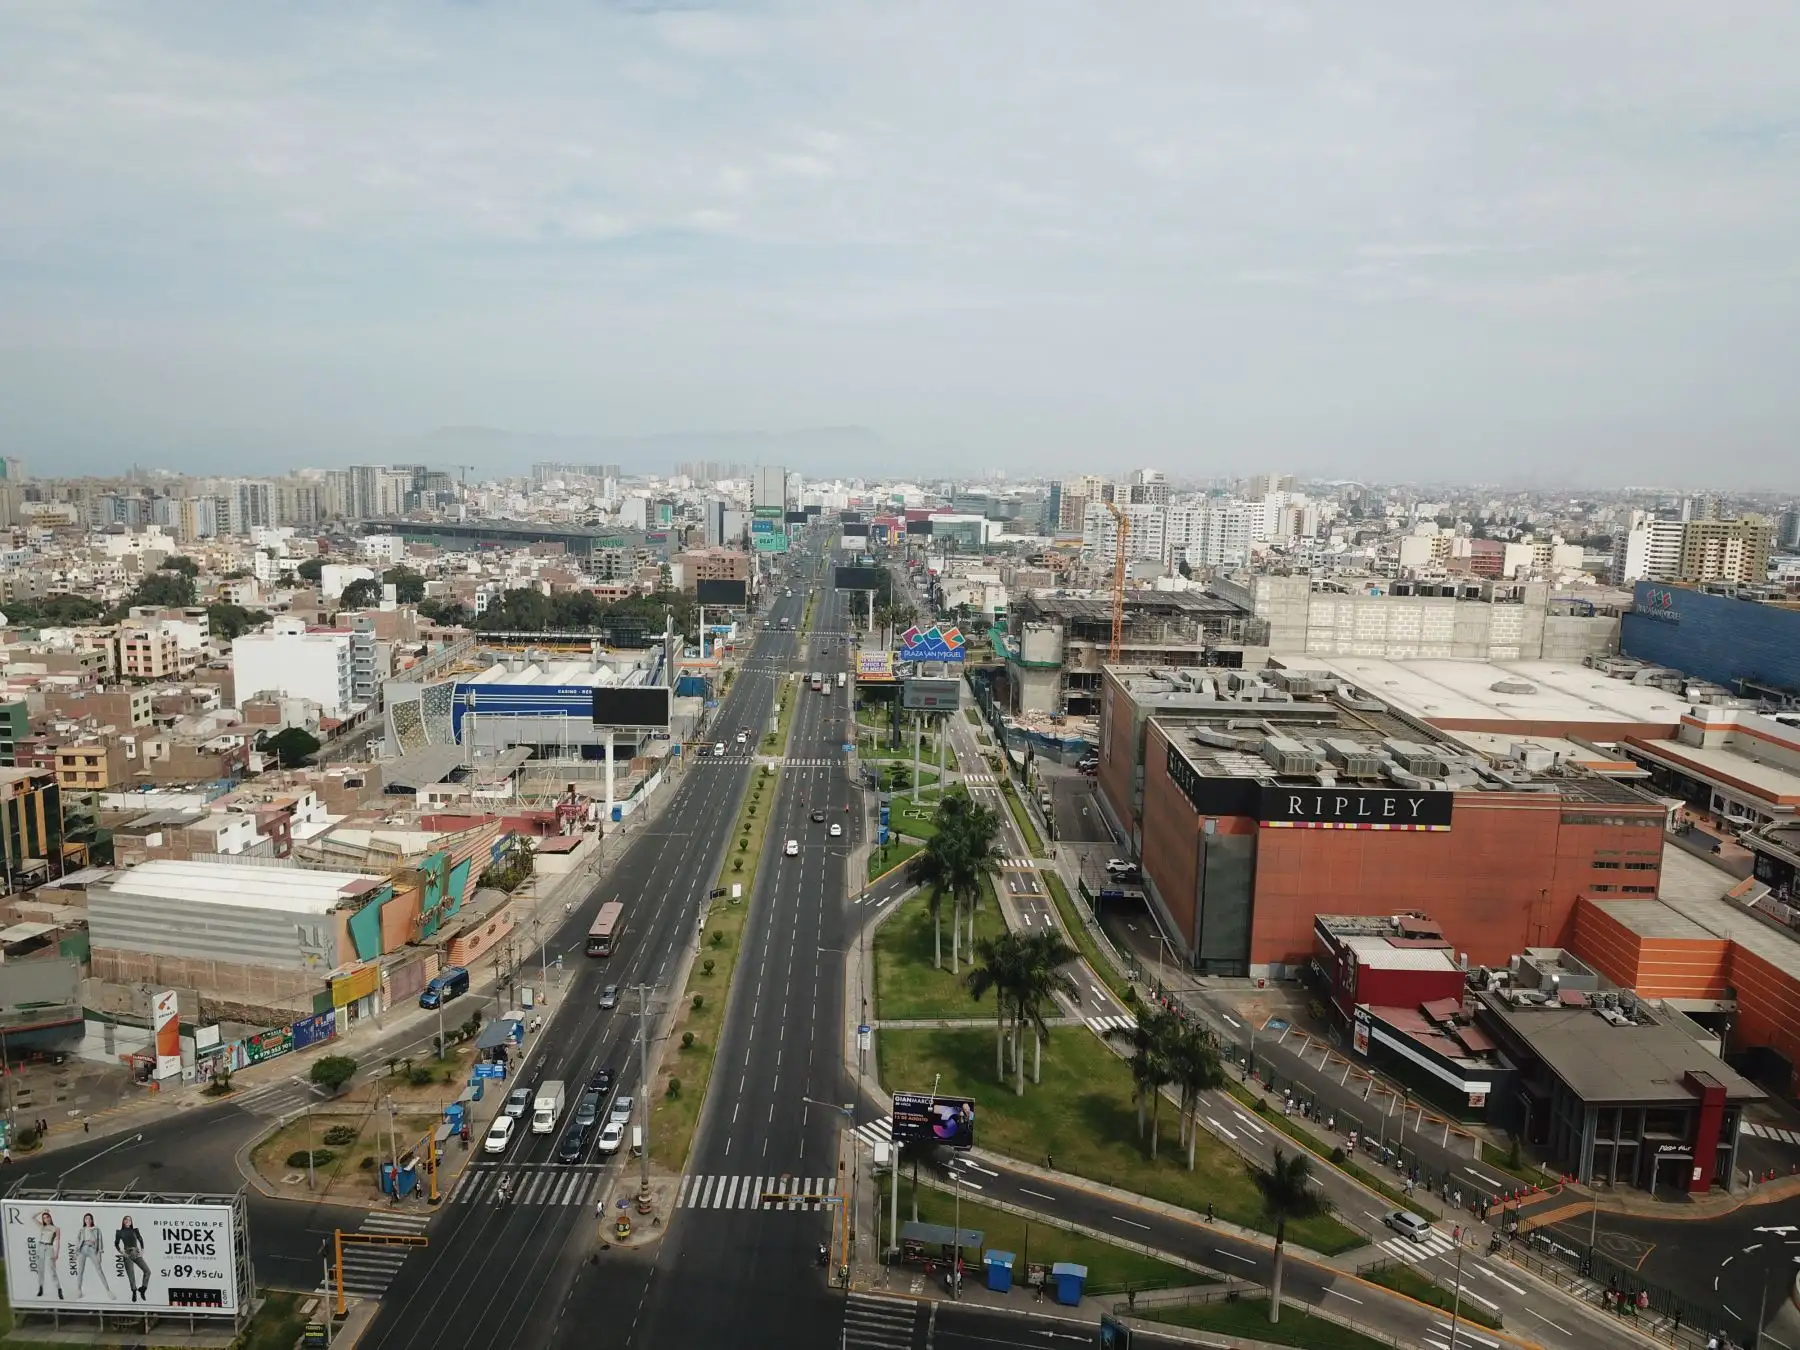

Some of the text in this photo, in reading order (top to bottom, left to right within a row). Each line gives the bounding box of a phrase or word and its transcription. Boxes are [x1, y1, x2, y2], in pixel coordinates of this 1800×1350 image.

[924, 650, 936, 659] SAN
[937, 651, 961, 659] MIGUEL
[1288, 796, 1425, 817] RIPLEY
[1354, 1007, 1372, 1024] KFC
[895, 1096, 934, 1104] GIANMARCO
[8, 1207, 24, 1225] R
[153, 1220, 224, 1228] RIPLEY.COM.PE
[162, 1228, 215, 1242] INDEX
[27, 1236, 39, 1273] JOGGER
[165, 1243, 216, 1255] JEANS
[68, 1243, 78, 1276] SKINNY
[115, 1254, 125, 1277] MOM
[160, 1269, 171, 1277] S/
[208, 1269, 223, 1279] c/u
[173, 1291, 217, 1299] RIPLEY
